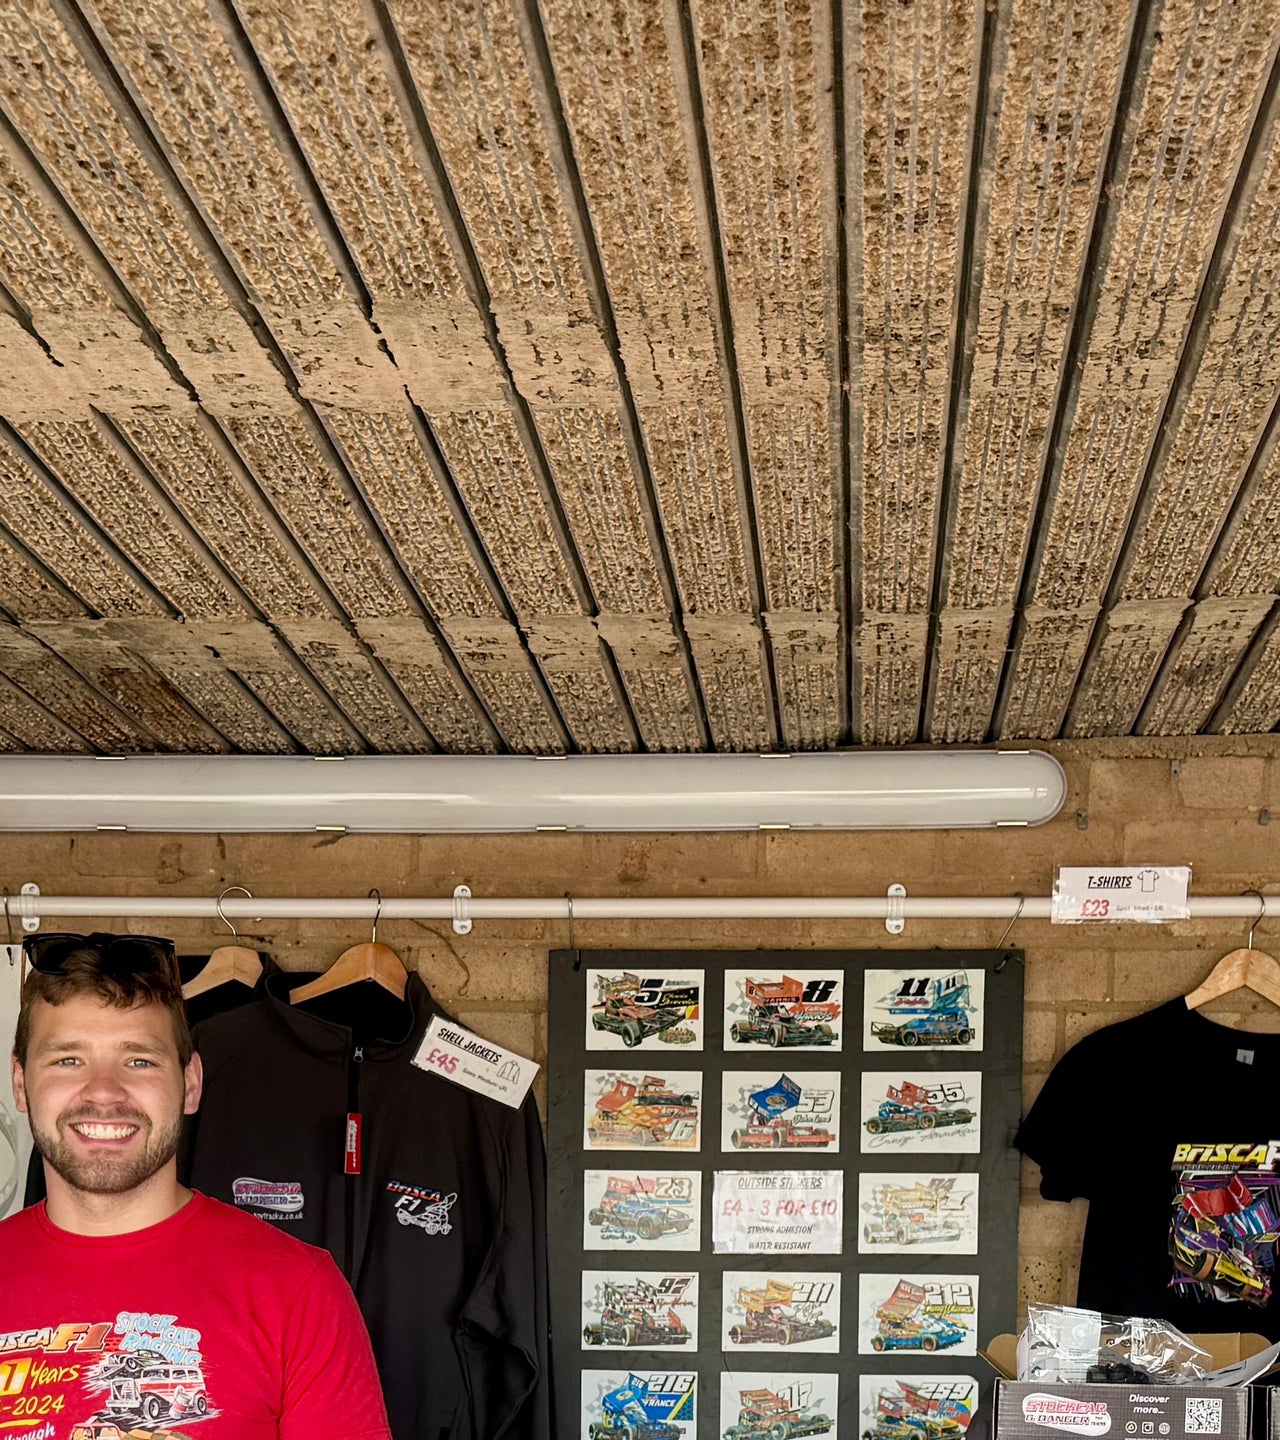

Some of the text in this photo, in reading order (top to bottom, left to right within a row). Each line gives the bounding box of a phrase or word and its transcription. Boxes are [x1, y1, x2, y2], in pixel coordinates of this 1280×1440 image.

[1088, 876, 1132, 888] T-SHIRTS
[1081, 899, 1110, 917] £23
[437, 1026, 502, 1065] SHELL JACKETS
[426, 1048, 460, 1075] £45
[738, 1176, 823, 1189] OUTSIDE STICKERS
[721, 1199, 838, 1217] £4 3 FOR £10
[747, 1224, 813, 1235] STRONG ADHESION
[748, 1240, 812, 1251] WATER RESISTANT
[115, 1311, 178, 1335] STOCK
[161, 1326, 202, 1350] CAR
[32, 1359, 81, 1390] Years
[647, 1374, 695, 1394] 216
[1025, 1400, 1107, 1414] STOCKCAR
[1128, 1394, 1170, 1404] Discover
[1037, 1415, 1091, 1426] BANGER
